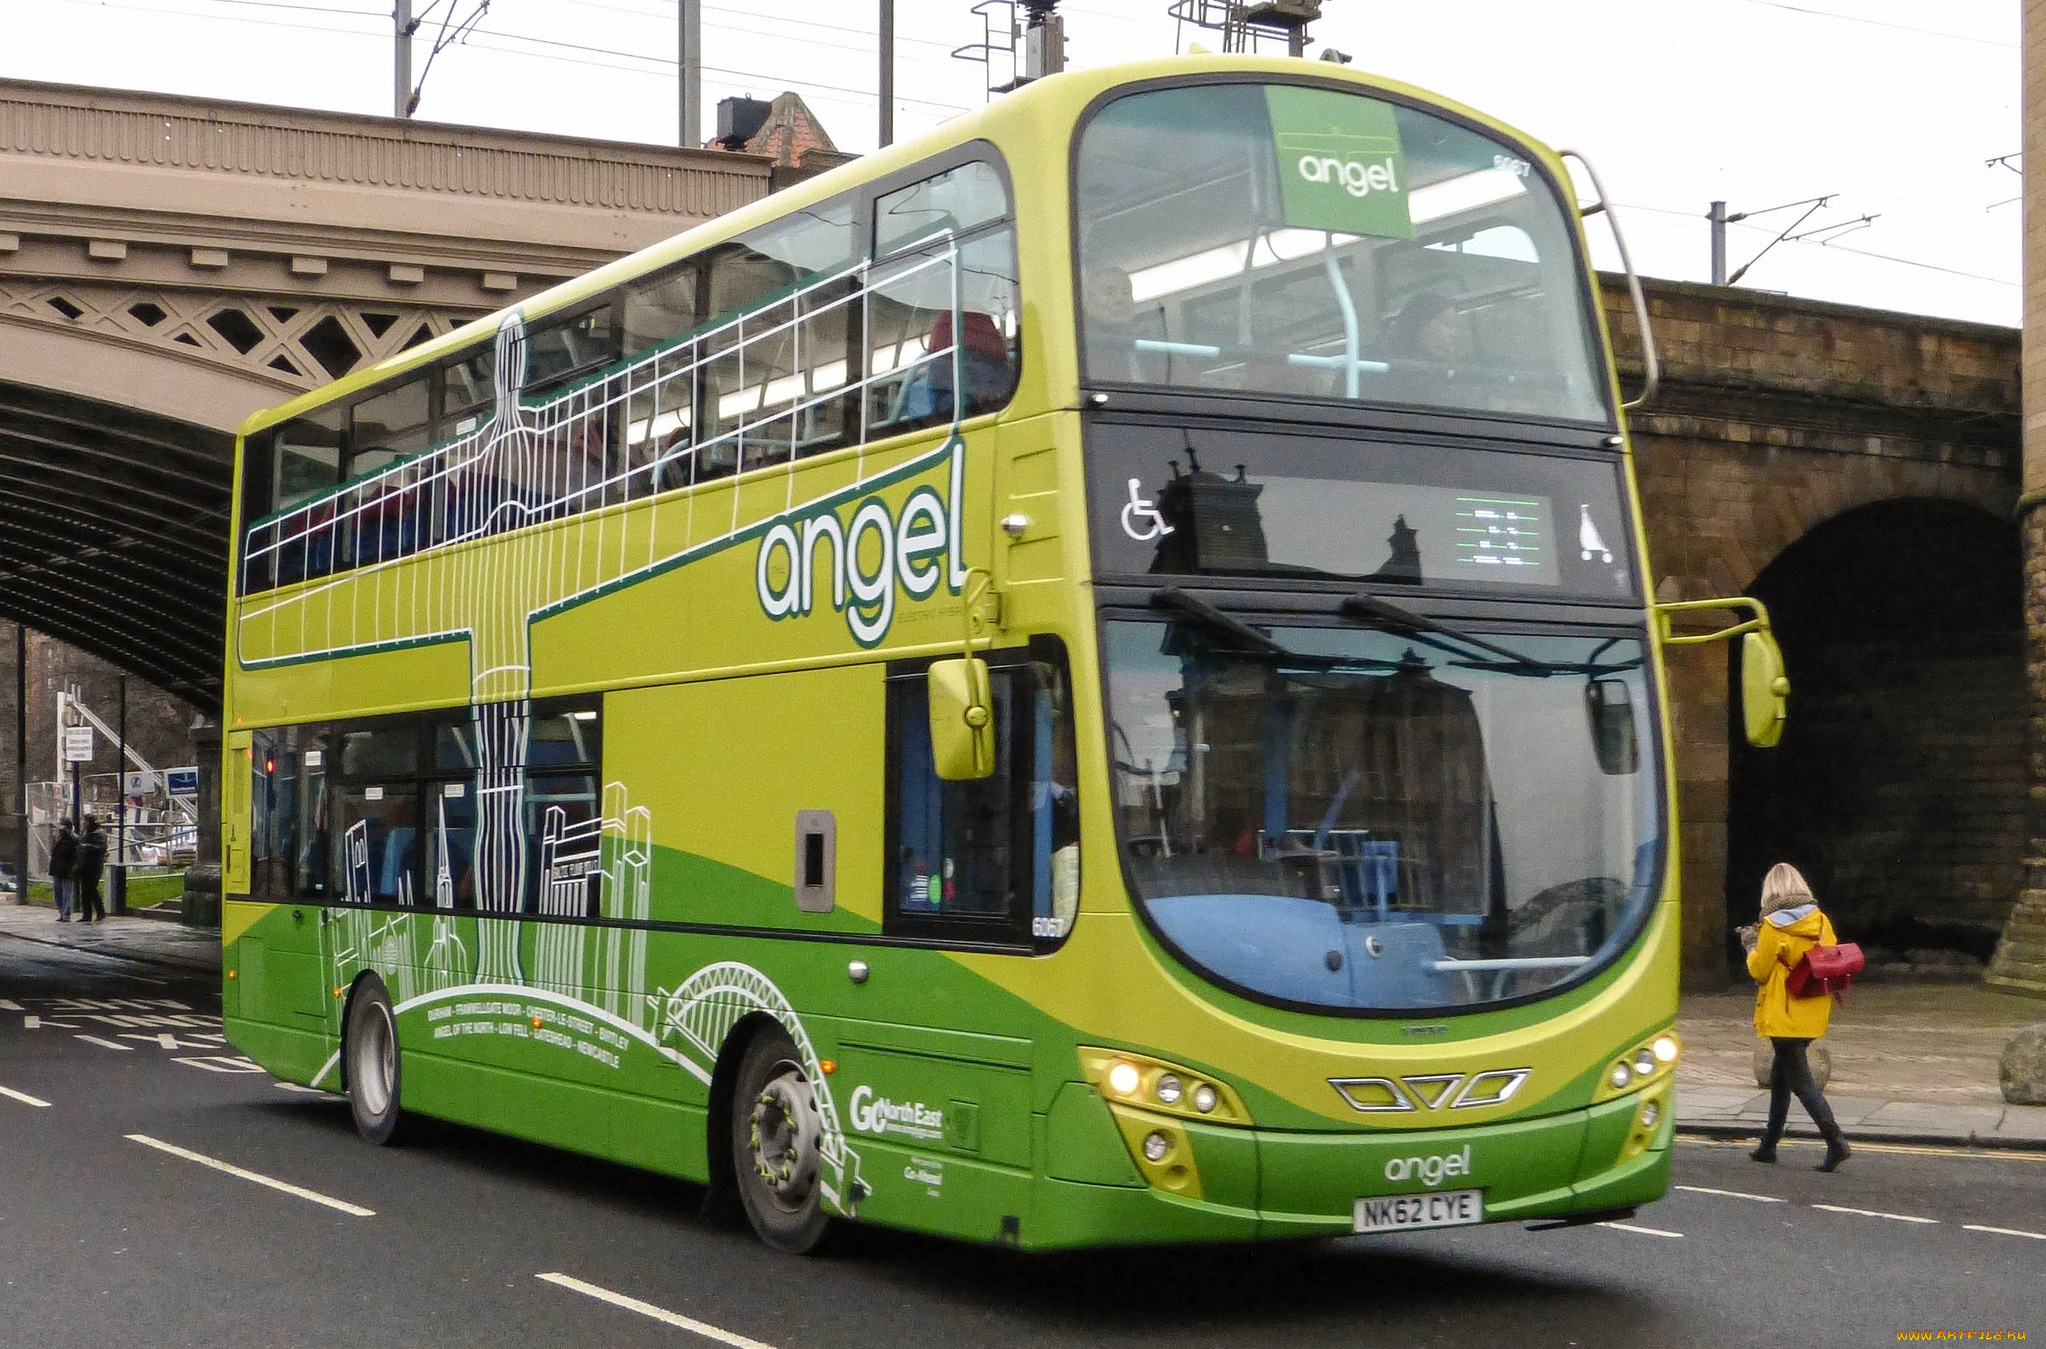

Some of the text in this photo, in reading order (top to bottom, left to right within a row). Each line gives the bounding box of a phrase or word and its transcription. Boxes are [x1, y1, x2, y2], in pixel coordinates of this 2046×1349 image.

[1298, 154, 1399, 197] angel
[757, 442, 966, 643] angel
[1385, 1144, 1471, 1187] angel
[1364, 1193, 1472, 1227] NK62 CYE
